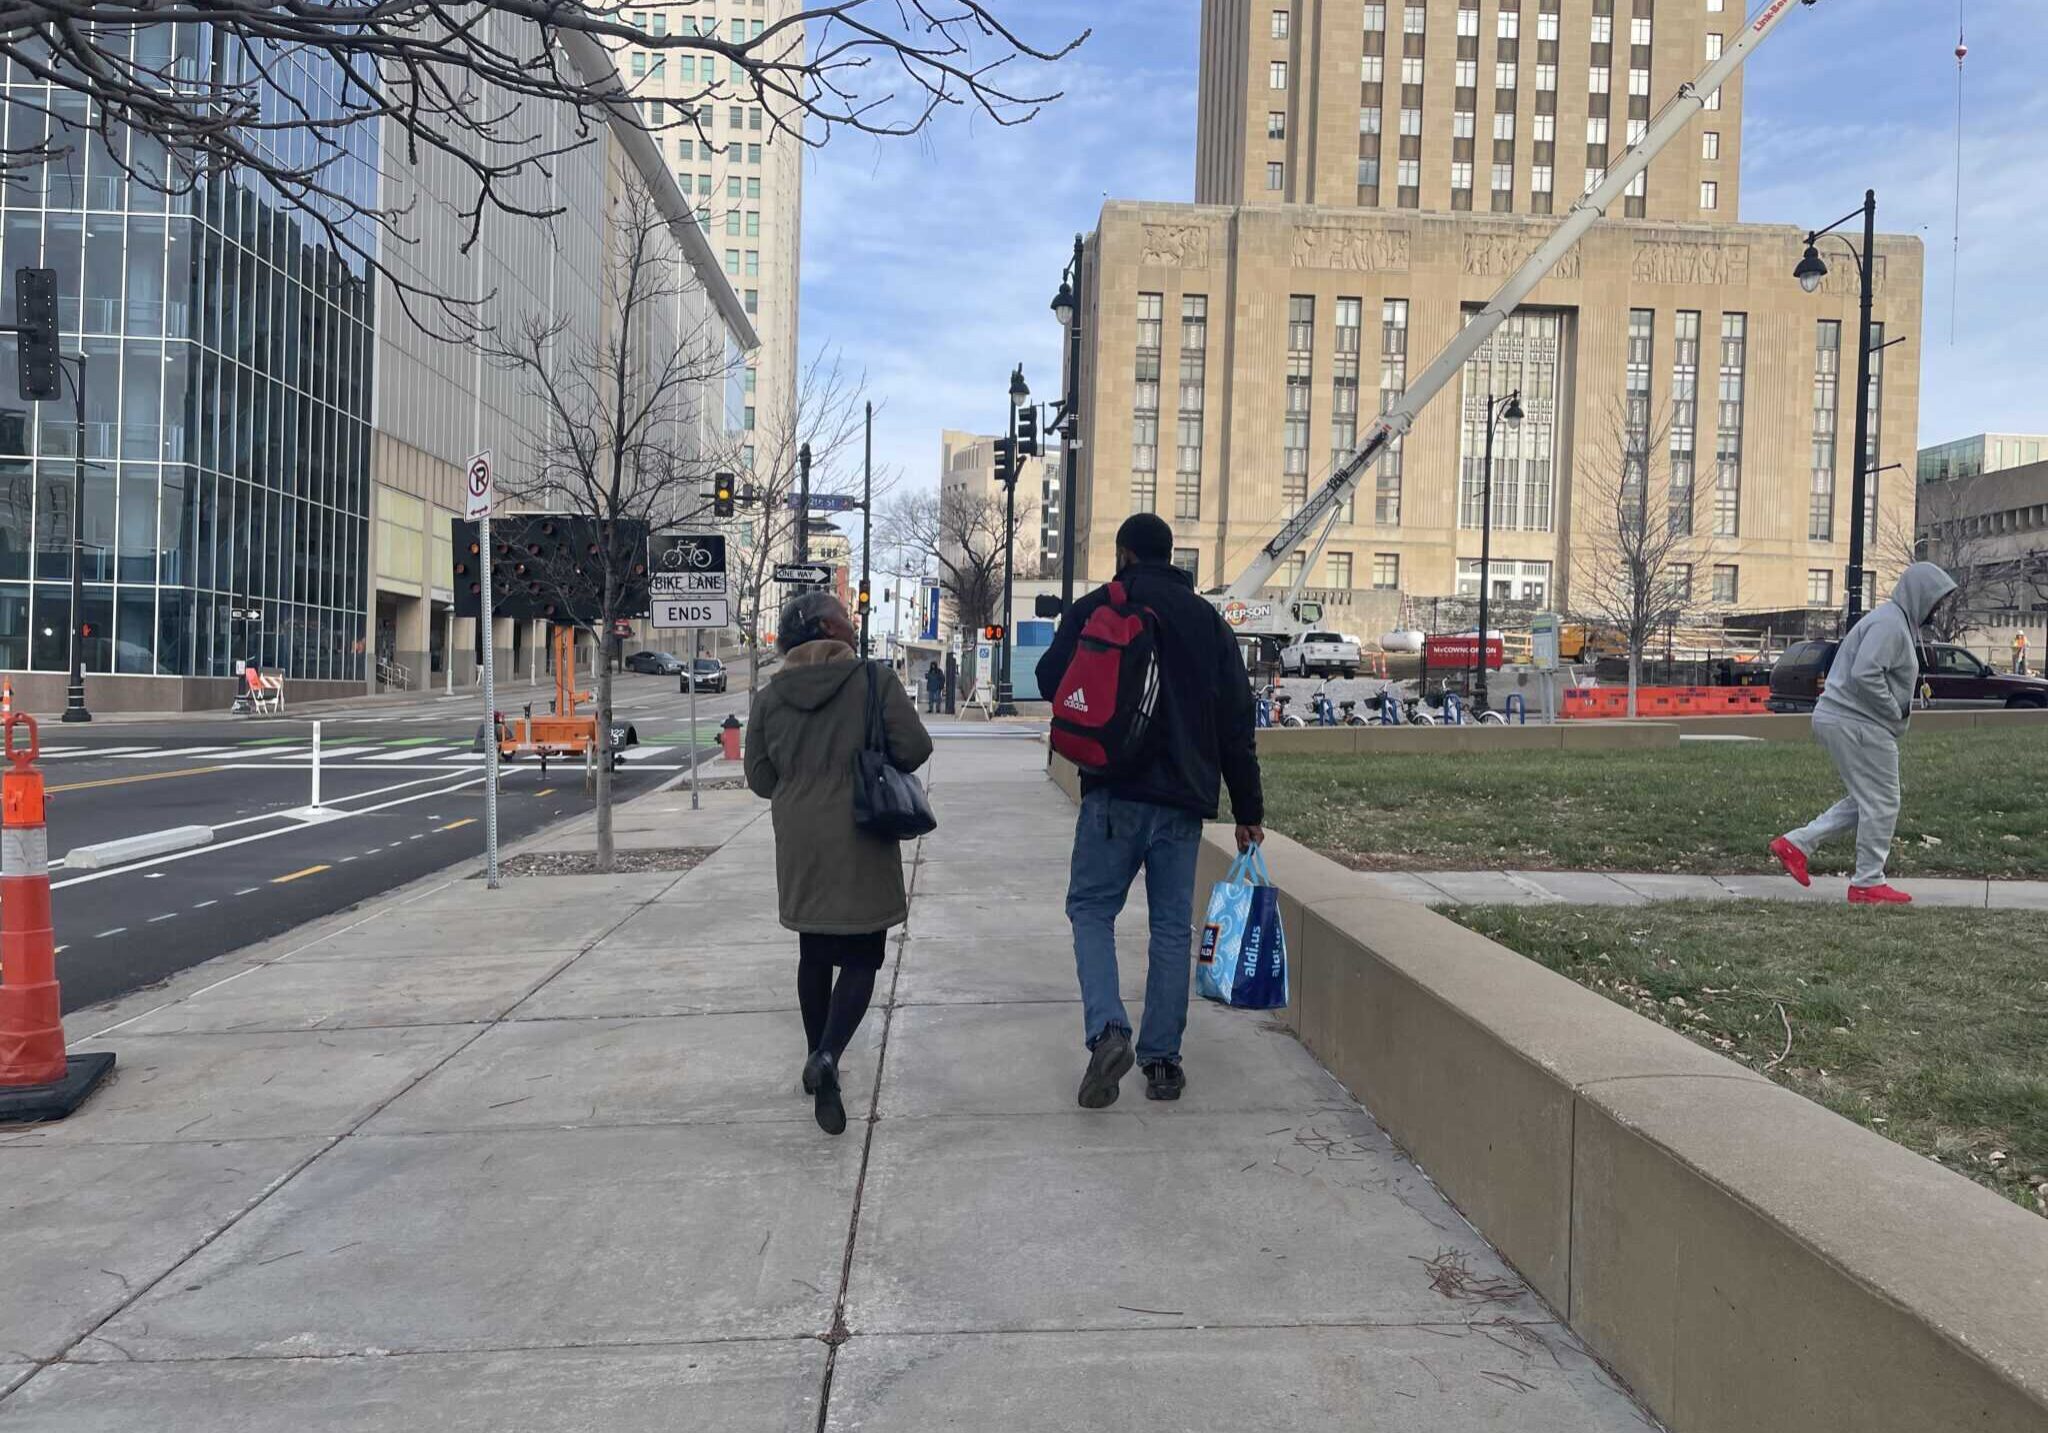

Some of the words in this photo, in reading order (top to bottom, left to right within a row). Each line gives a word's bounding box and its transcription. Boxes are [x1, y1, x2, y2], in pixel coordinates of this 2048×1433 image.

[779, 570, 793, 578] ONE
[797, 570, 814, 578] WAY
[655, 576, 683, 590] BIKE
[688, 576, 721, 590] LANE
[668, 606, 712, 621] ENDS
[1063, 699, 1088, 712] adidas
[1243, 925, 1261, 977] aldi.us
